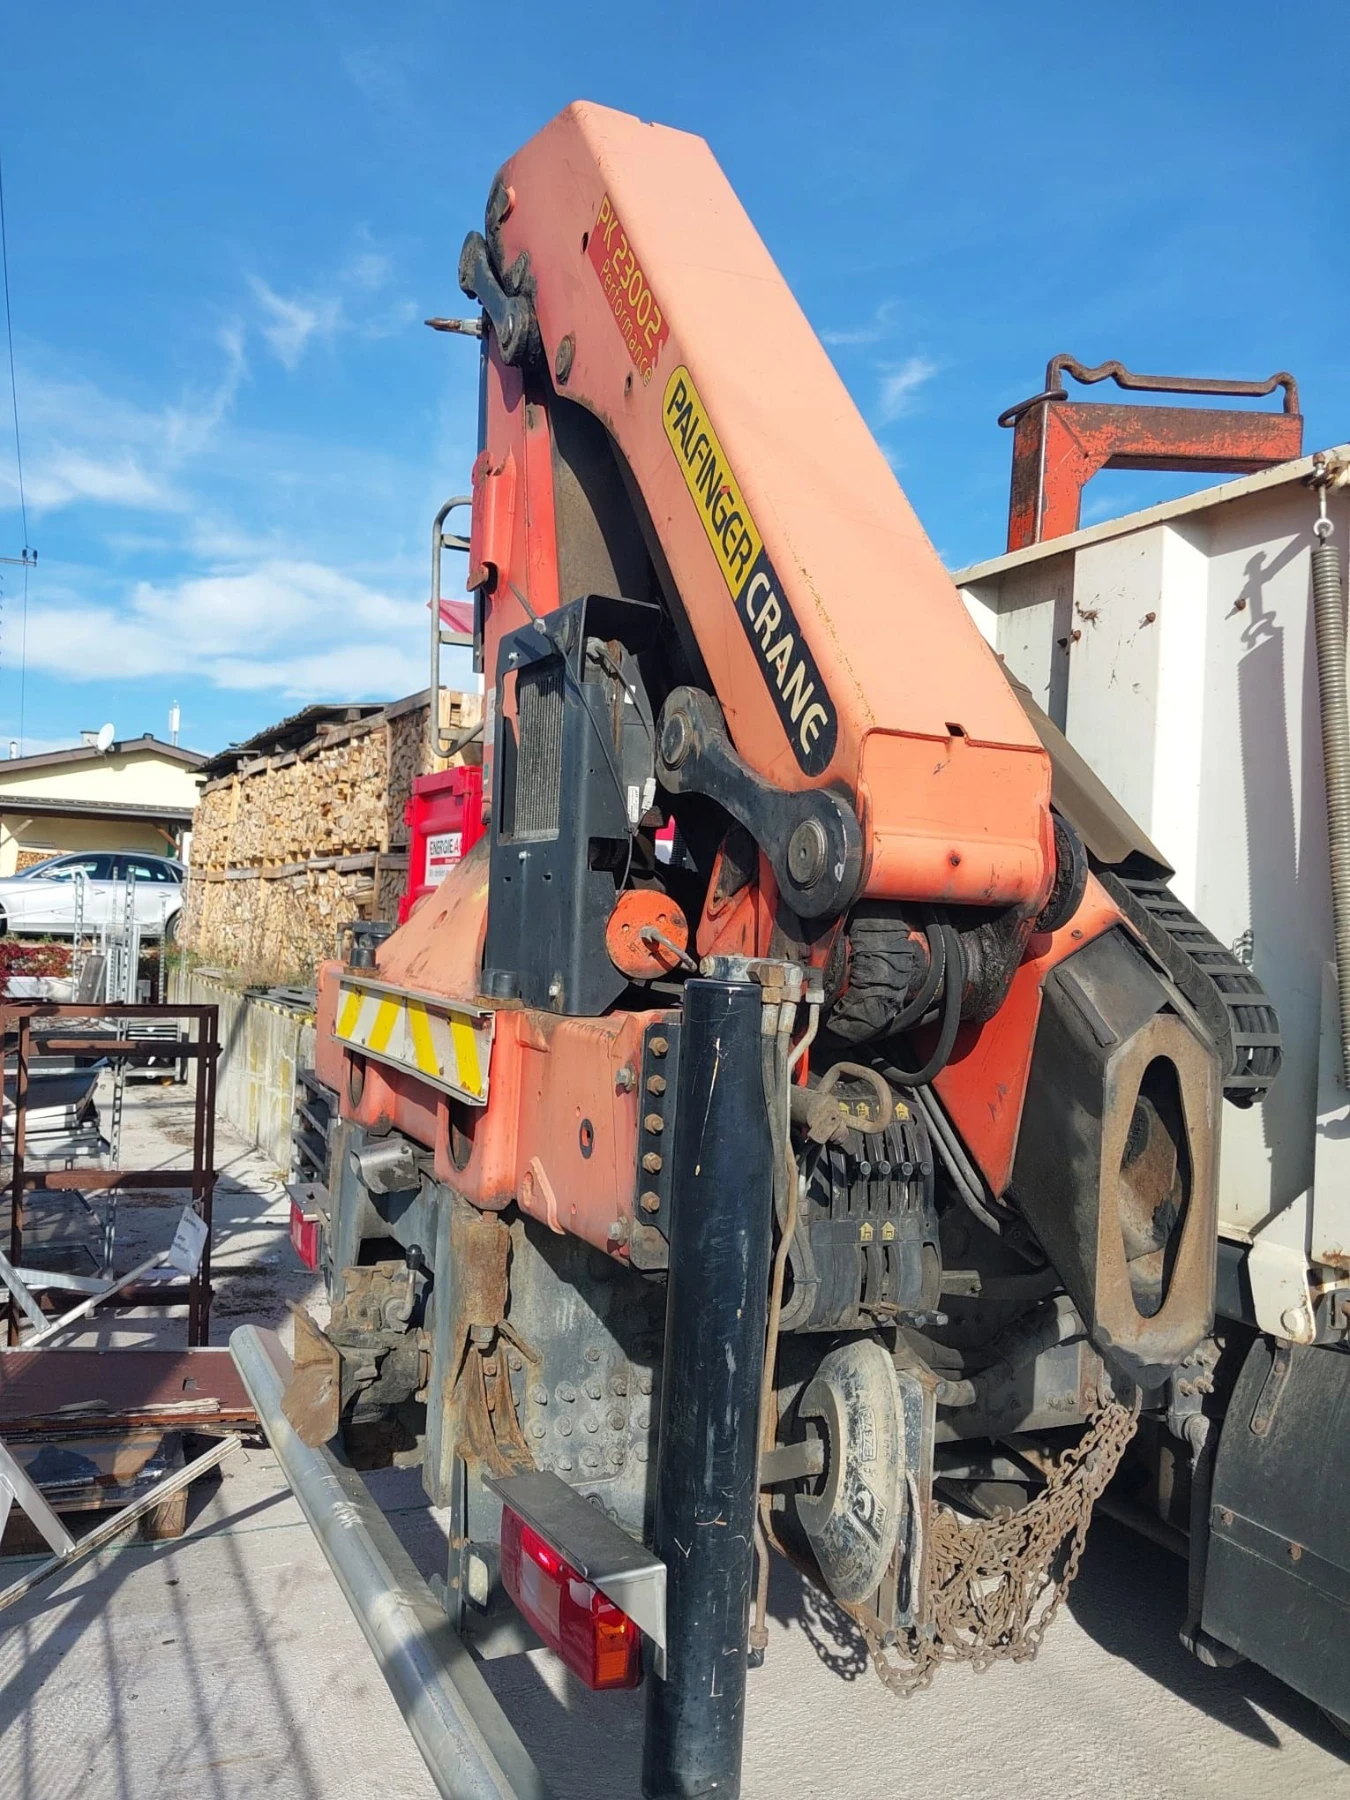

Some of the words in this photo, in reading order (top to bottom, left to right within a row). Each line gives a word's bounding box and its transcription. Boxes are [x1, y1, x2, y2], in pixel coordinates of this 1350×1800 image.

[596, 195, 620, 252] PK
[612, 233, 662, 349] 23002
[600, 258, 652, 387] Performance
[667, 377, 753, 584] PALFINGER
[746, 572, 828, 755] CRANE
[430, 838, 454, 855] ENERGIE
